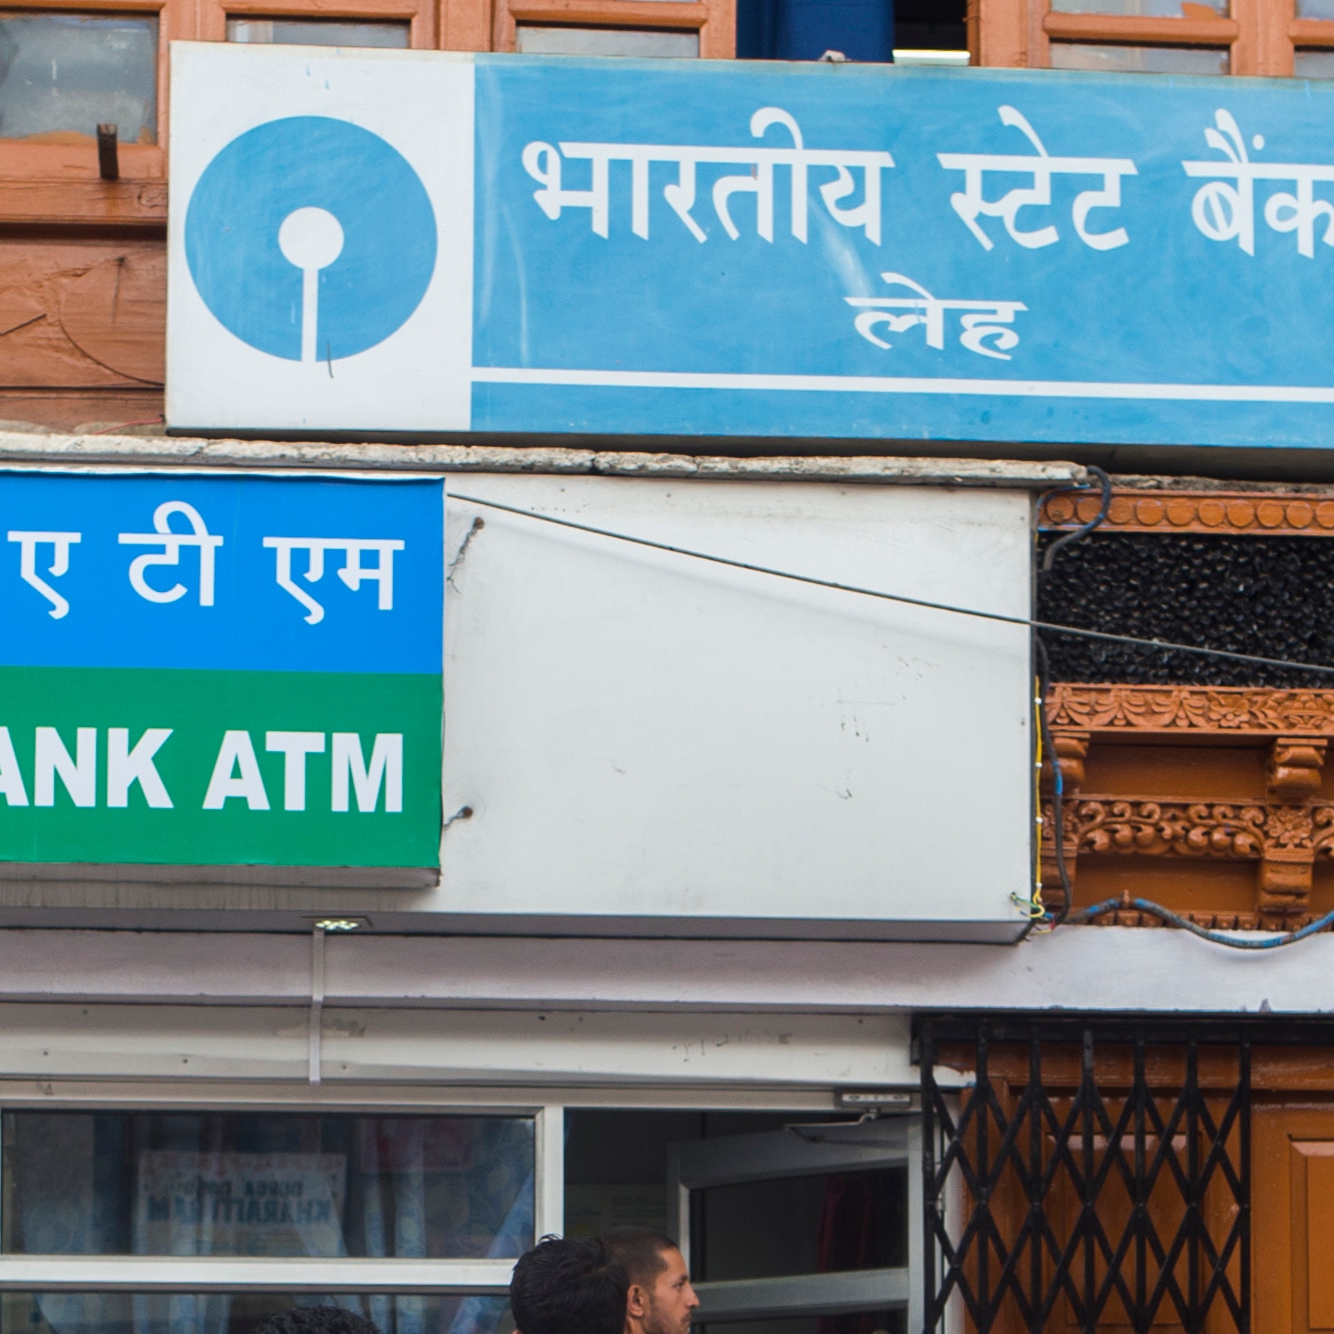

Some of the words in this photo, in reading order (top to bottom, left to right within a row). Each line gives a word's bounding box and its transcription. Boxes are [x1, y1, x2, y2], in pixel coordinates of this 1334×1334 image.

[522, 106, 896, 246] भारतीय
[936, 105, 1138, 252] स्टेट
[844, 271, 1028, 361] लेह
[7, 530, 82, 621] ए
[117, 500, 224, 608] टी
[262, 536, 406, 626] एम
[201, 729, 404, 814] ATM
